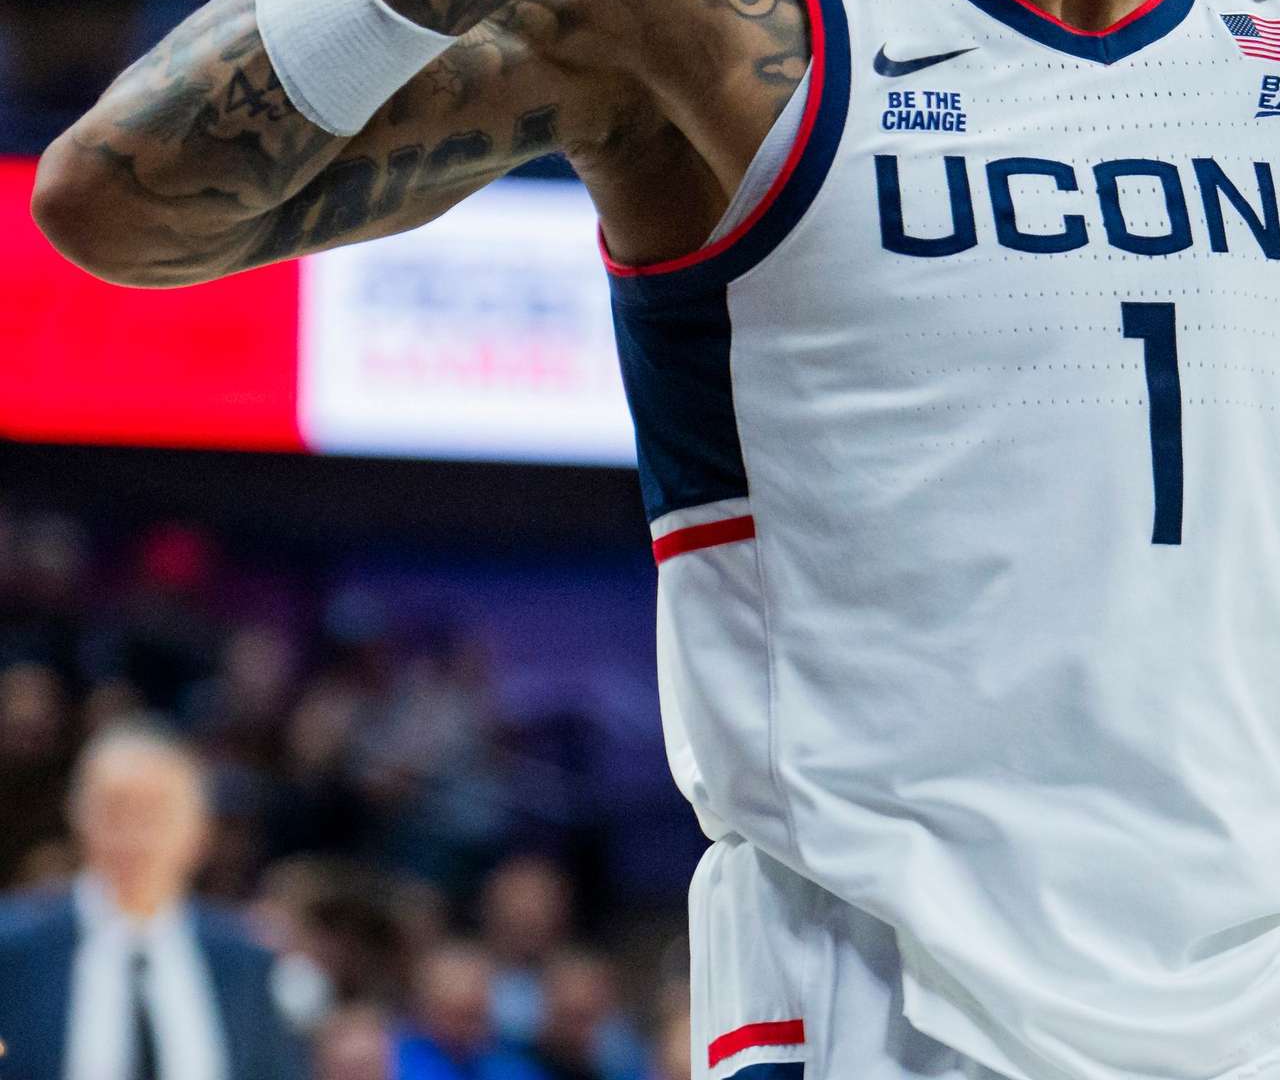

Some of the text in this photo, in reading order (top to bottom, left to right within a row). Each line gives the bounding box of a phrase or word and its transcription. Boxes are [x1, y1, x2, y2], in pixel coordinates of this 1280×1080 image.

[888, 91, 962, 111] BE THE
[882, 110, 967, 133] CHANGE
[1120, 302, 1184, 545] 1
